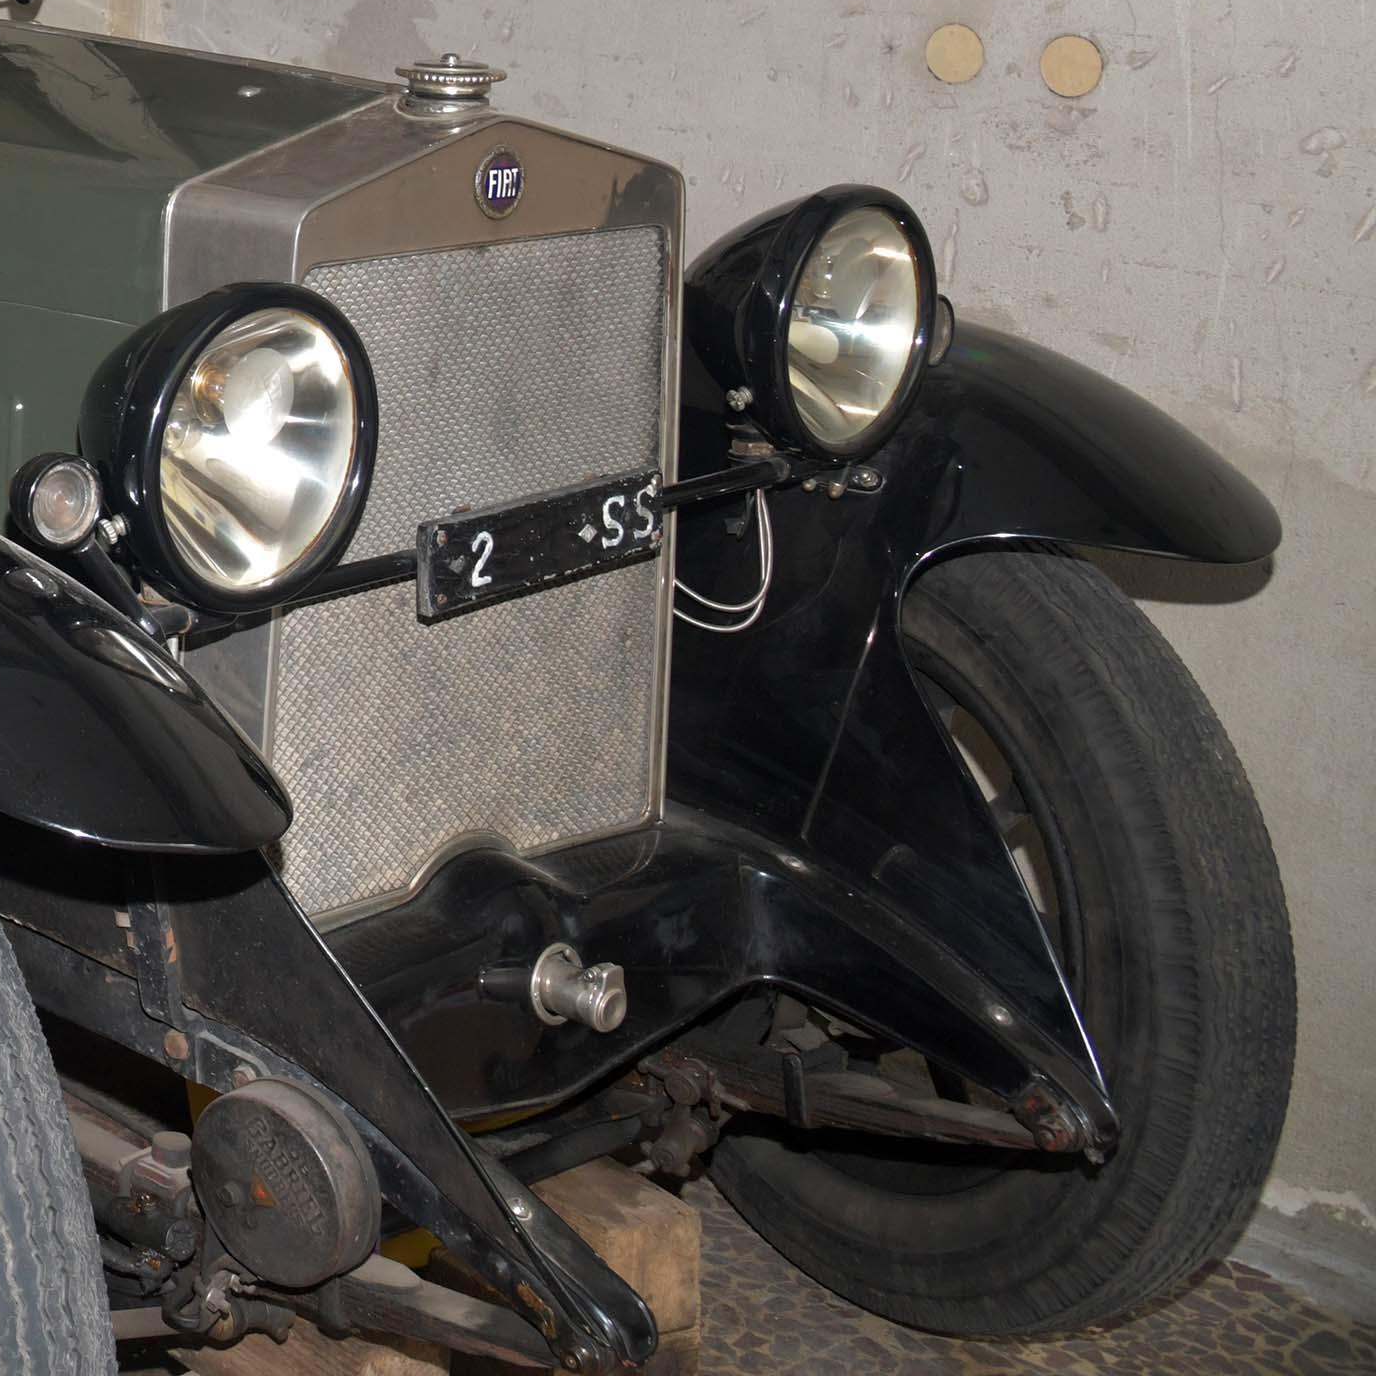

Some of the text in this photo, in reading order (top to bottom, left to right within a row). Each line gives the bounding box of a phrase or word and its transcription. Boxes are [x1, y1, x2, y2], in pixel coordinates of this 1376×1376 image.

[488, 168, 519, 199] FIAT
[471, 484, 657, 588] 2 SS
